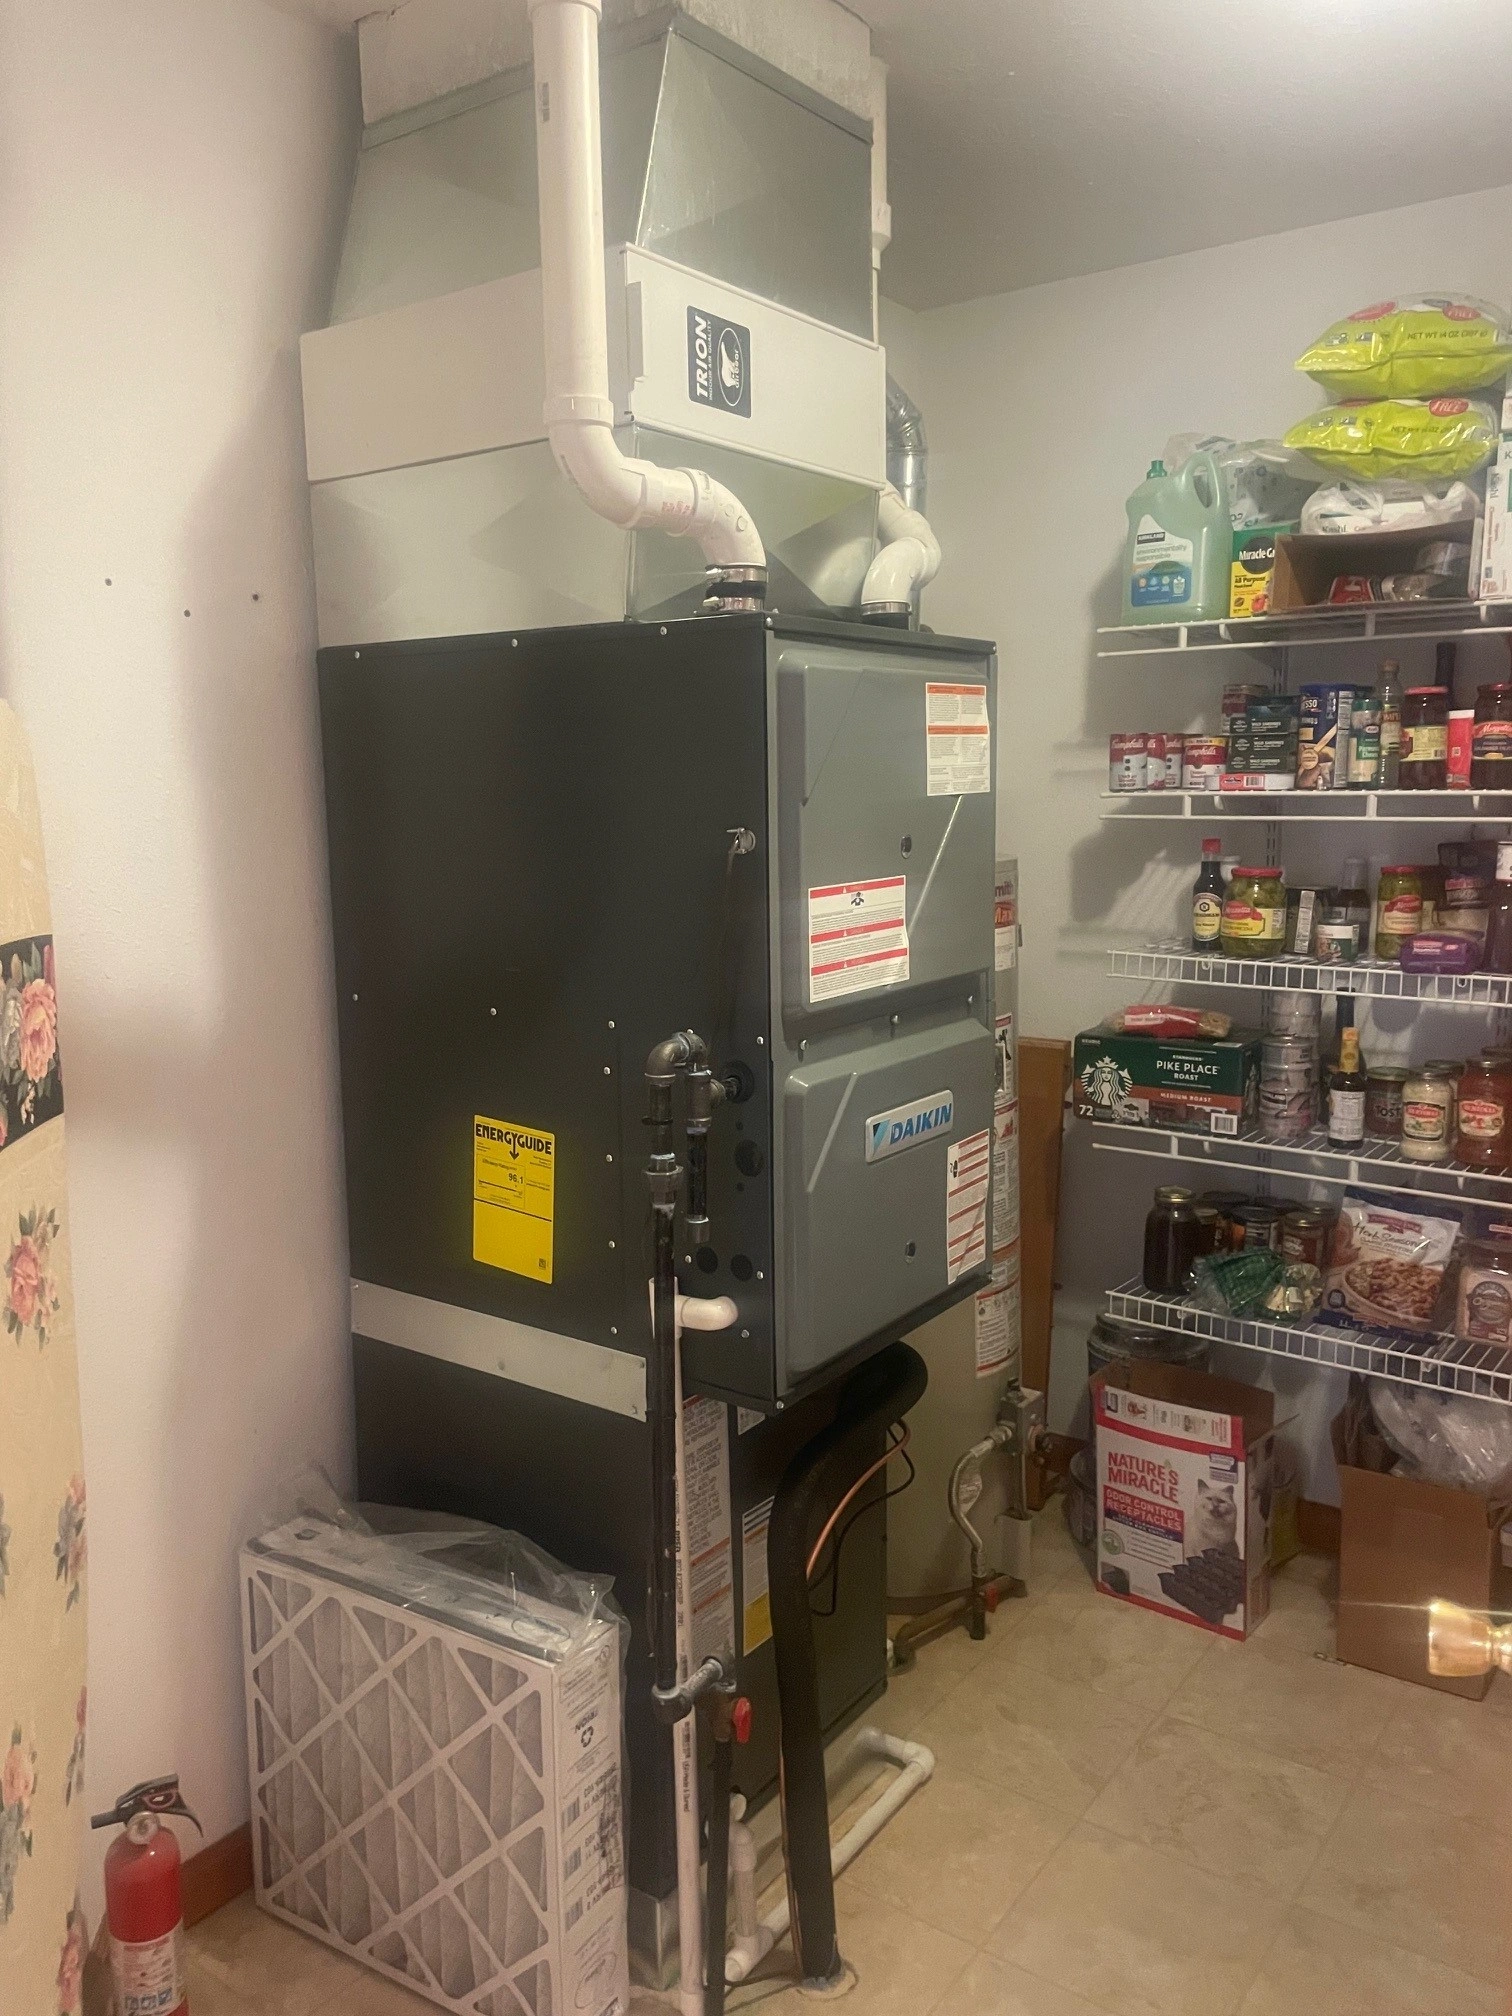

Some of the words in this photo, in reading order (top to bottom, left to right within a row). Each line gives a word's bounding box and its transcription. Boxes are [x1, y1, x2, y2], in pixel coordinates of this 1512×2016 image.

[1407, 331, 1423, 340] NET
[1425, 331, 1437, 339] WT
[1448, 330, 1460, 338] OZ
[694, 315, 709, 398] TRION
[1431, 400, 1465, 414] FREE
[1138, 533, 1165, 542] KIRKLAND
[1239, 549, 1266, 560] Miracle
[1172, 1054, 1203, 1062] STARBUCKS
[1156, 1060, 1180, 1071] PIKE
[1183, 1062, 1218, 1075] PLACE
[1173, 1072, 1199, 1081] ROAST
[1160, 1092, 1188, 1100] MEDIUM
[1189, 1095, 1212, 1103] ROAST
[1079, 1104, 1094, 1117] 72
[889, 1102, 953, 1146] DAIKIN
[475, 1122, 552, 1159] ENERGYGUIDE
[508, 1172, 524, 1184] 96.1
[1352, 1221, 1380, 1240] Herb
[1107, 1466, 1180, 1505] MIRACLE
[1105, 1488, 1132, 1506] ODOR
[1133, 1498, 1181, 1522] CONTROL
[1105, 1498, 1182, 1532] RECEPTACLES
